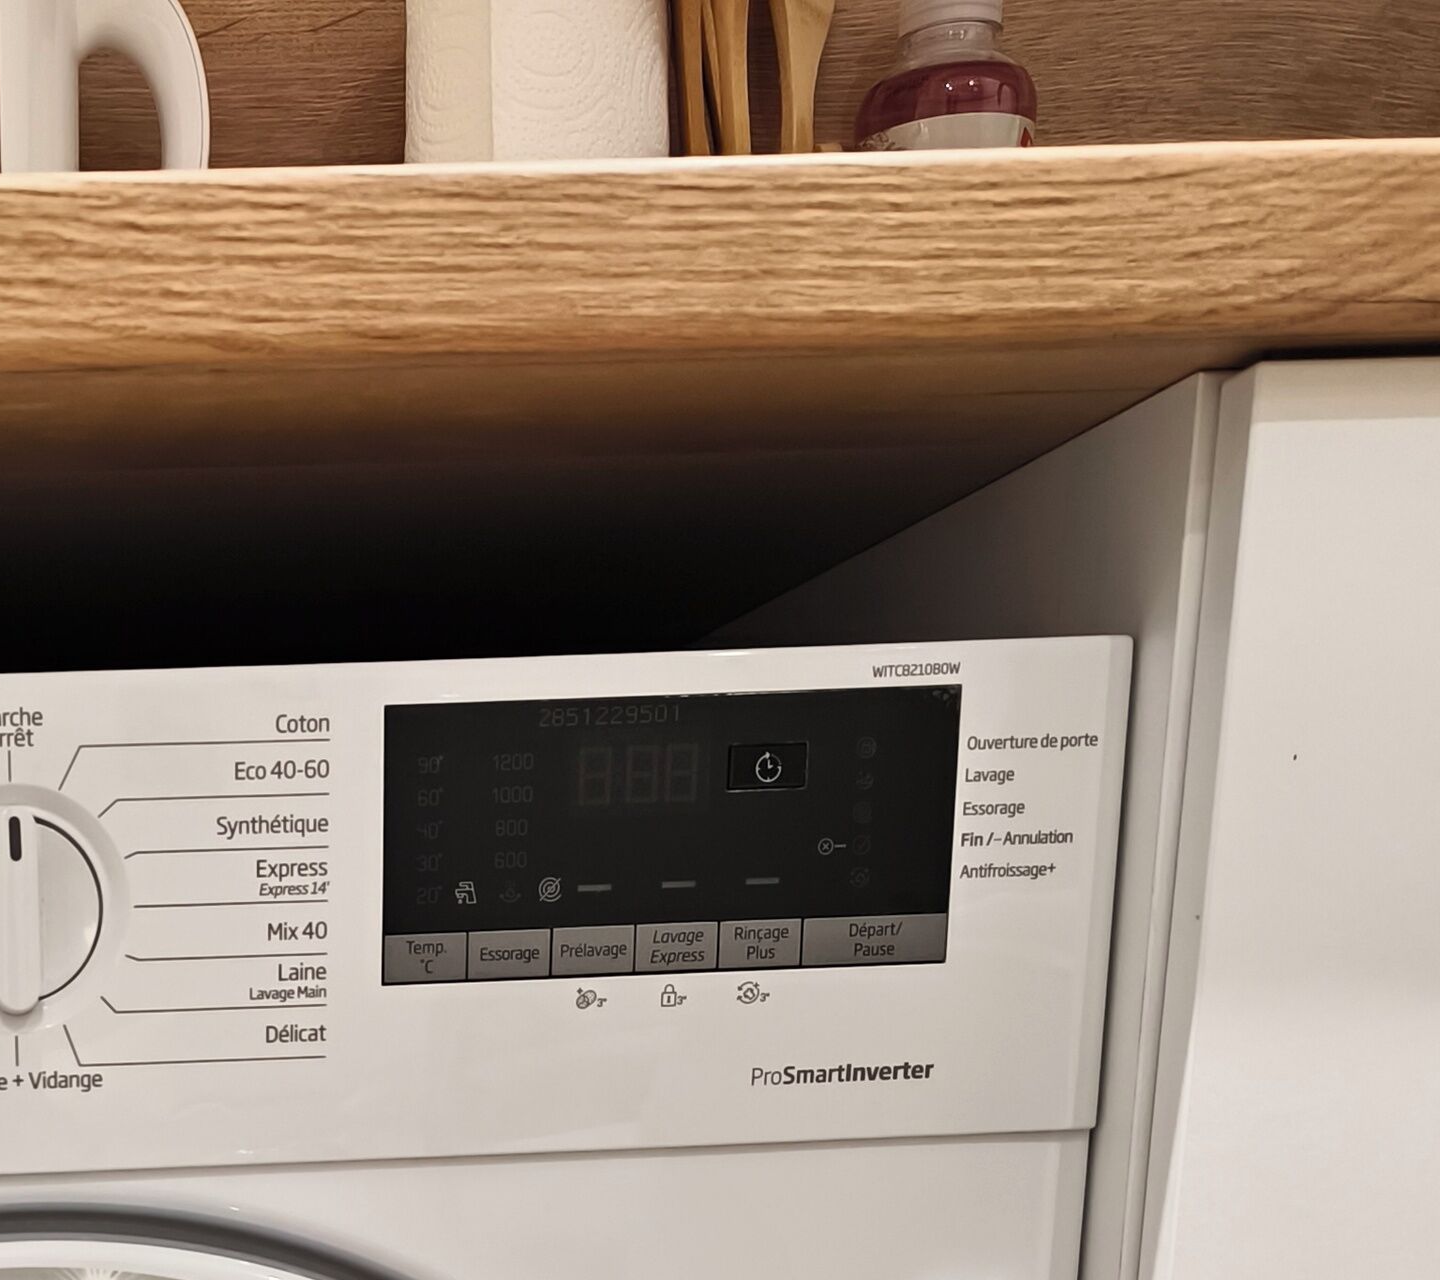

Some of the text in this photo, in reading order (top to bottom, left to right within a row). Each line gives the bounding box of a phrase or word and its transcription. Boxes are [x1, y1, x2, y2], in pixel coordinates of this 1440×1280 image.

[275, 714, 330, 734] Coton
[539, 704, 681, 727] 2851229501
[967, 731, 1099, 751] Ouverture de porte
[234, 759, 330, 780] Eco 40-60
[492, 753, 534, 772] 1200
[965, 767, 1015, 784] Lavage
[492, 786, 534, 804] 1000
[963, 801, 1025, 819] Essorage
[217, 815, 329, 839] Synthétique
[961, 831, 984, 847] Fin
[256, 859, 328, 880] Express
[960, 863, 1056, 879] Antifroissage+
[259, 883, 309, 899] Express
[267, 921, 328, 941] Mix 40
[653, 929, 704, 946] Lavage
[734, 925, 789, 942] Rinçage
[849, 922, 903, 938] Départ/
[406, 940, 447, 956] Temp.
[480, 948, 540, 964] Essorage
[560, 942, 627, 960] Prélavage
[746, 945, 776, 960] Plus
[853, 942, 895, 958] Pause
[650, 949, 705, 966] Express
[277, 963, 327, 981] Laine
[249, 985, 327, 1002] Lavage Main
[265, 1022, 327, 1043] Délicat
[13, 1074, 24, 1087] +
[28, 1071, 103, 1092] Vidange
